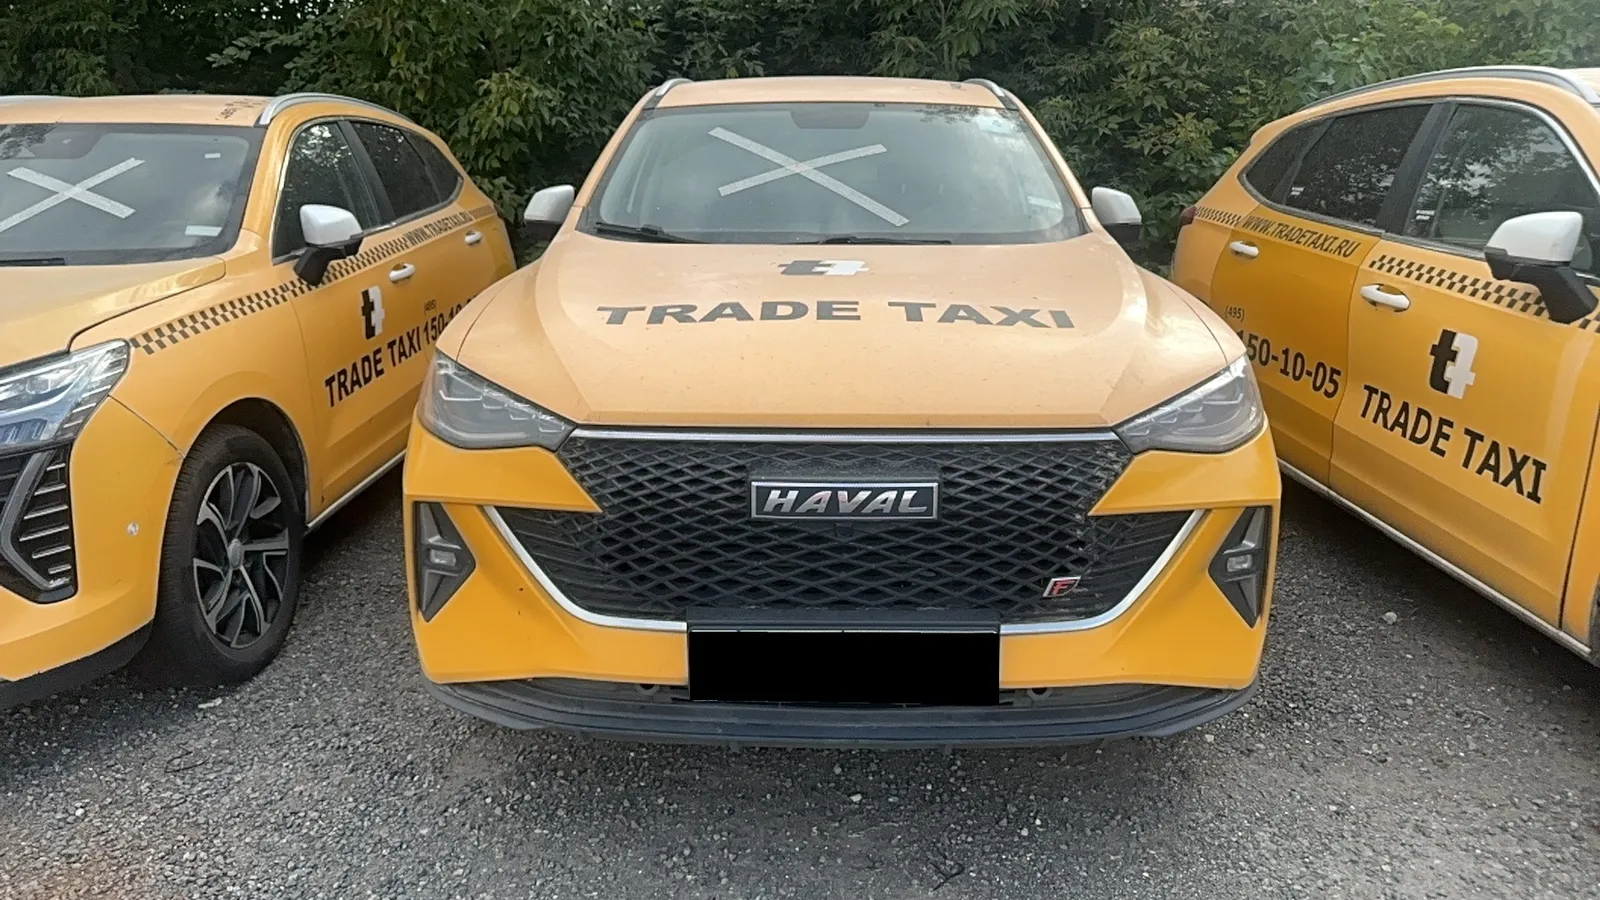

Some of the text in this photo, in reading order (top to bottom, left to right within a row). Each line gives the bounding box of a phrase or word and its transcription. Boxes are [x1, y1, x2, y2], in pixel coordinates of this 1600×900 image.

[1242, 216, 1361, 258] WWW.TRADETAXI.RU
[597, 300, 1075, 328] TRADE TAXI
[1225, 304, 1245, 323] (495)
[324, 347, 384, 407] TRADE
[387, 326, 422, 367] TAXI
[1360, 384, 1547, 504] TRADE TAXI
[763, 490, 928, 513] HAVAL
